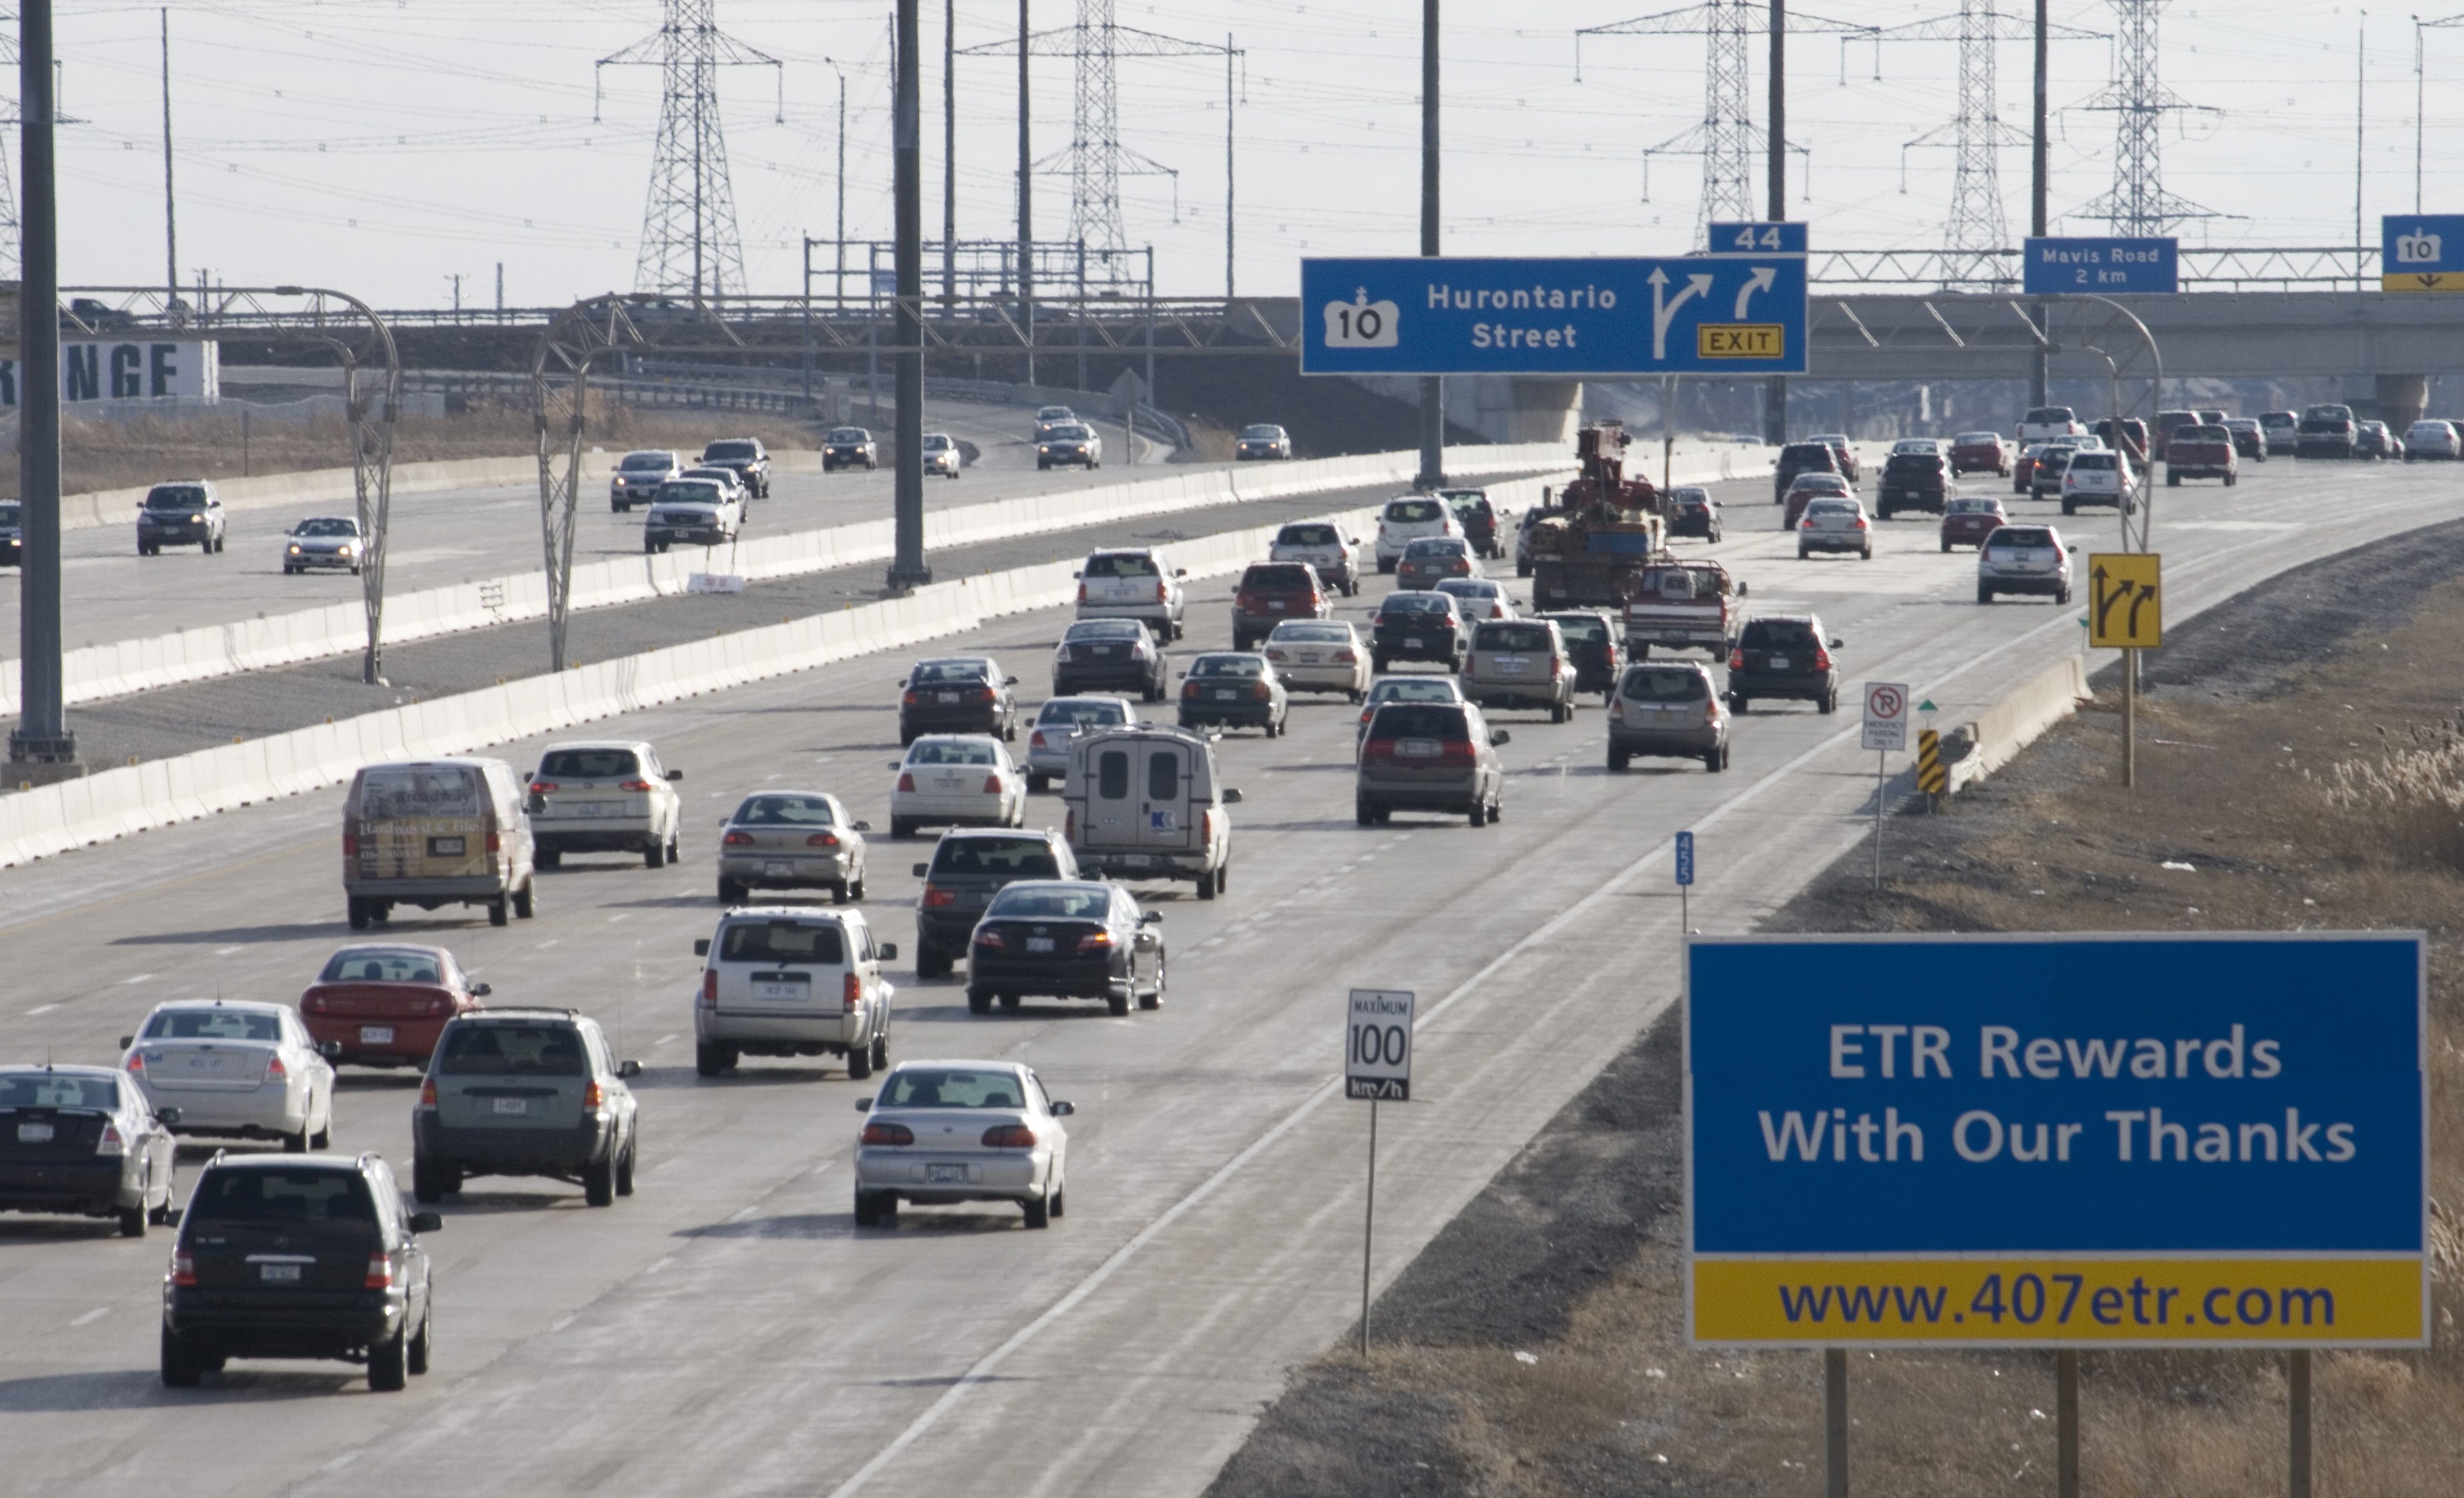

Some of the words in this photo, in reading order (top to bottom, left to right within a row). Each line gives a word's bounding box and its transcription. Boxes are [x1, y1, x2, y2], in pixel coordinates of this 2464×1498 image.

[1734, 227, 1781, 250] 44
[2405, 240, 2432, 259] 10
[2043, 248, 2099, 263] Mavis
[2111, 248, 2159, 263] Road
[2076, 269, 2087, 284] 2
[2098, 269, 2126, 283] km
[1428, 284, 1616, 310] Hurontario
[1339, 309, 1382, 339] 10
[1472, 323, 1577, 348] Street
[1710, 328, 1771, 351] EXIT
[360, 820, 431, 836] Hardwood
[435, 821, 447, 832] &
[1354, 999, 1408, 1016] MAXIMUM
[1352, 1024, 1406, 1066] 100
[1830, 1025, 1952, 1078] ETR
[1981, 1023, 2282, 1079] Rewards
[1351, 1079, 1403, 1099] km/h
[1758, 1107, 1923, 1162] With
[1952, 1109, 2082, 1162] Our
[2105, 1107, 2356, 1162] Thanks
[1779, 1273, 2334, 1326] www.407etr.com
